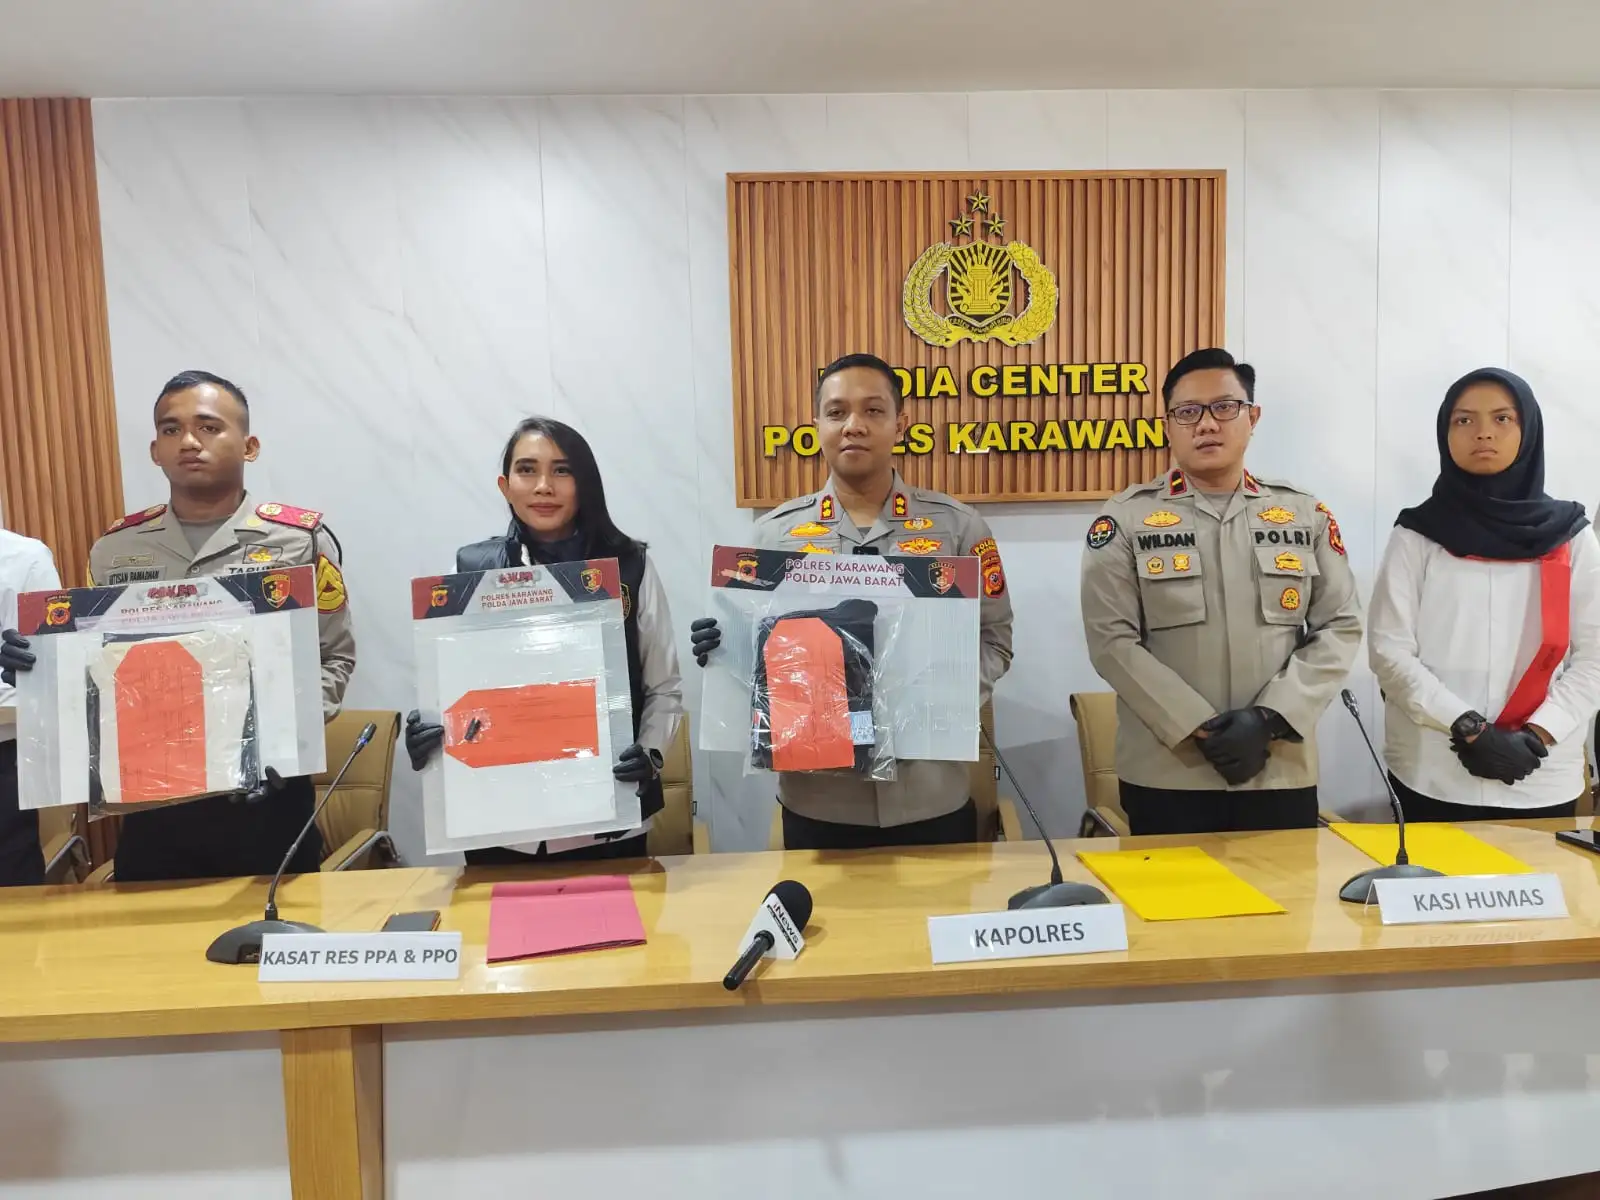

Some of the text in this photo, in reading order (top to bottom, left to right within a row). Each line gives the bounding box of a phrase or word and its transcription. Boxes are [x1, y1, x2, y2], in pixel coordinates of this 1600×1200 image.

[969, 363, 1149, 398] CENTER
[763, 417, 1167, 458] POS KARAWAN
[1137, 532, 1196, 550] WILDAN
[1254, 530, 1311, 546] POLRI
[785, 559, 905, 574] POLRES KARAWANG
[785, 572, 904, 587] POLDA JAWA BARAT
[481, 588, 553, 602] POLRES KARAWANG
[482, 596, 553, 609] POLDA JAWA BARAT
[1412, 888, 1545, 912] KASI HUMAS
[974, 922, 1085, 948] KAPOLRES
[263, 949, 458, 965] KASAT RES PPA & PPO
